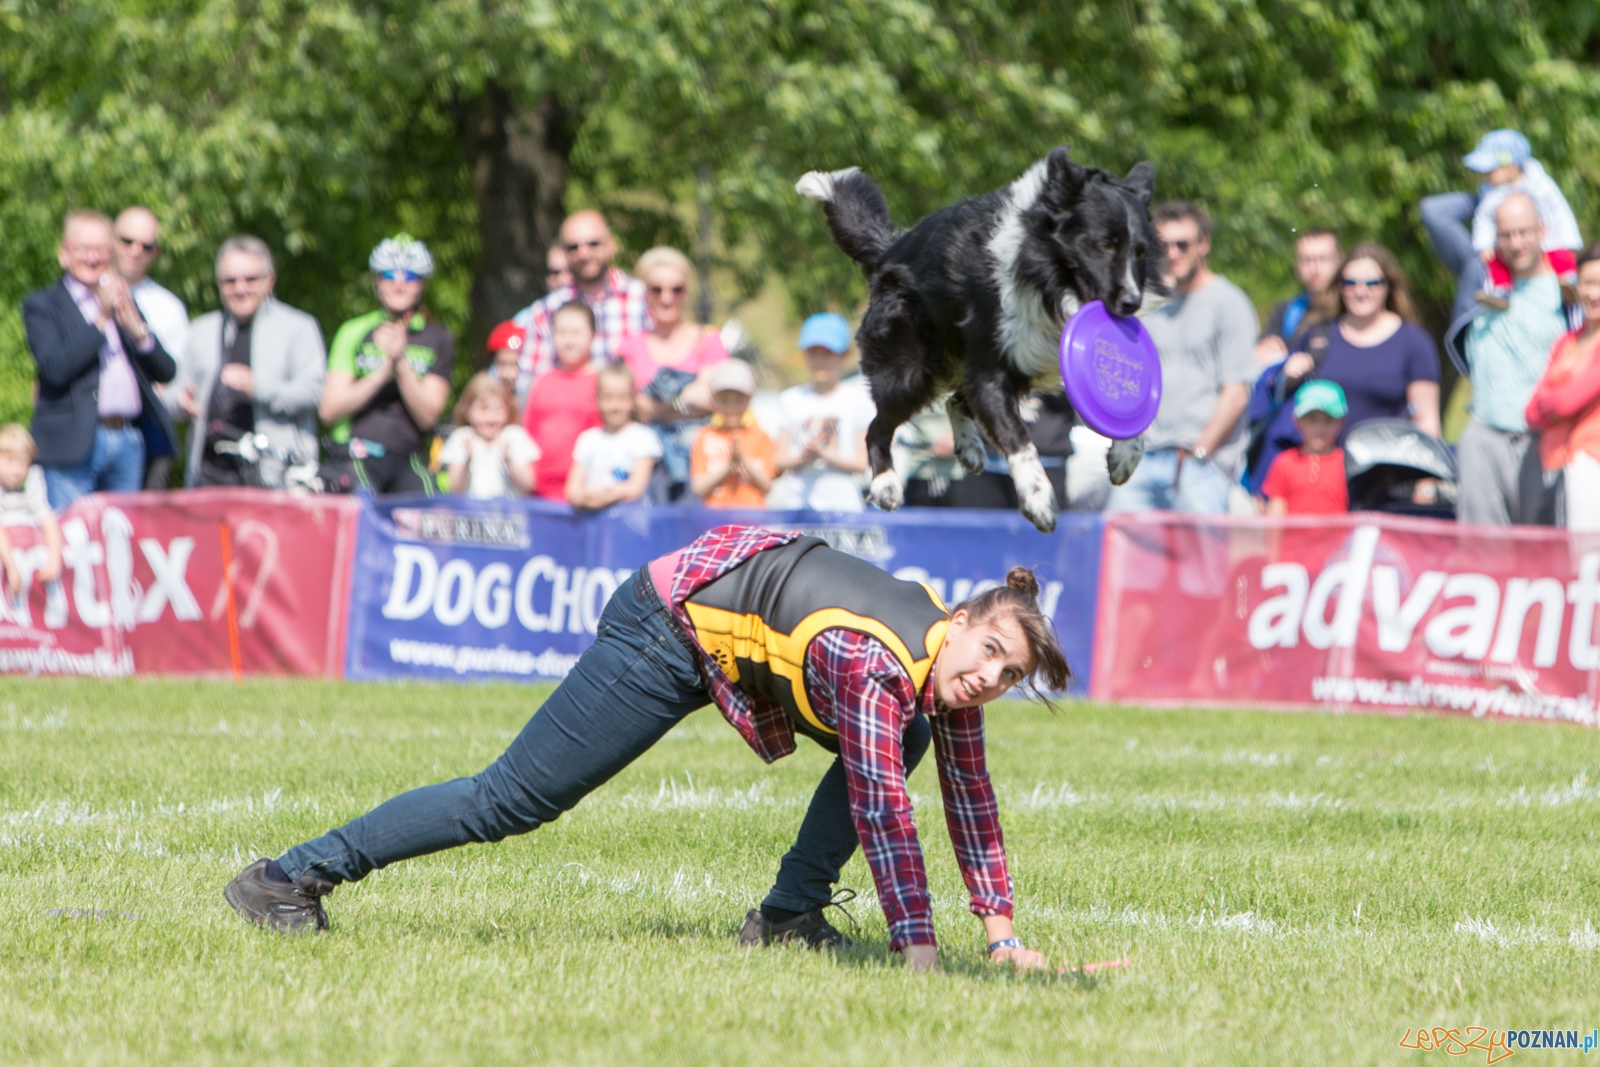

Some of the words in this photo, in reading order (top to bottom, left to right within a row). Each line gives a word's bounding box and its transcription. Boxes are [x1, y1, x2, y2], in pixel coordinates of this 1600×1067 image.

[422, 512, 519, 545] PURINA
[382, 544, 512, 629] DOG
[1248, 525, 1600, 670] advant
